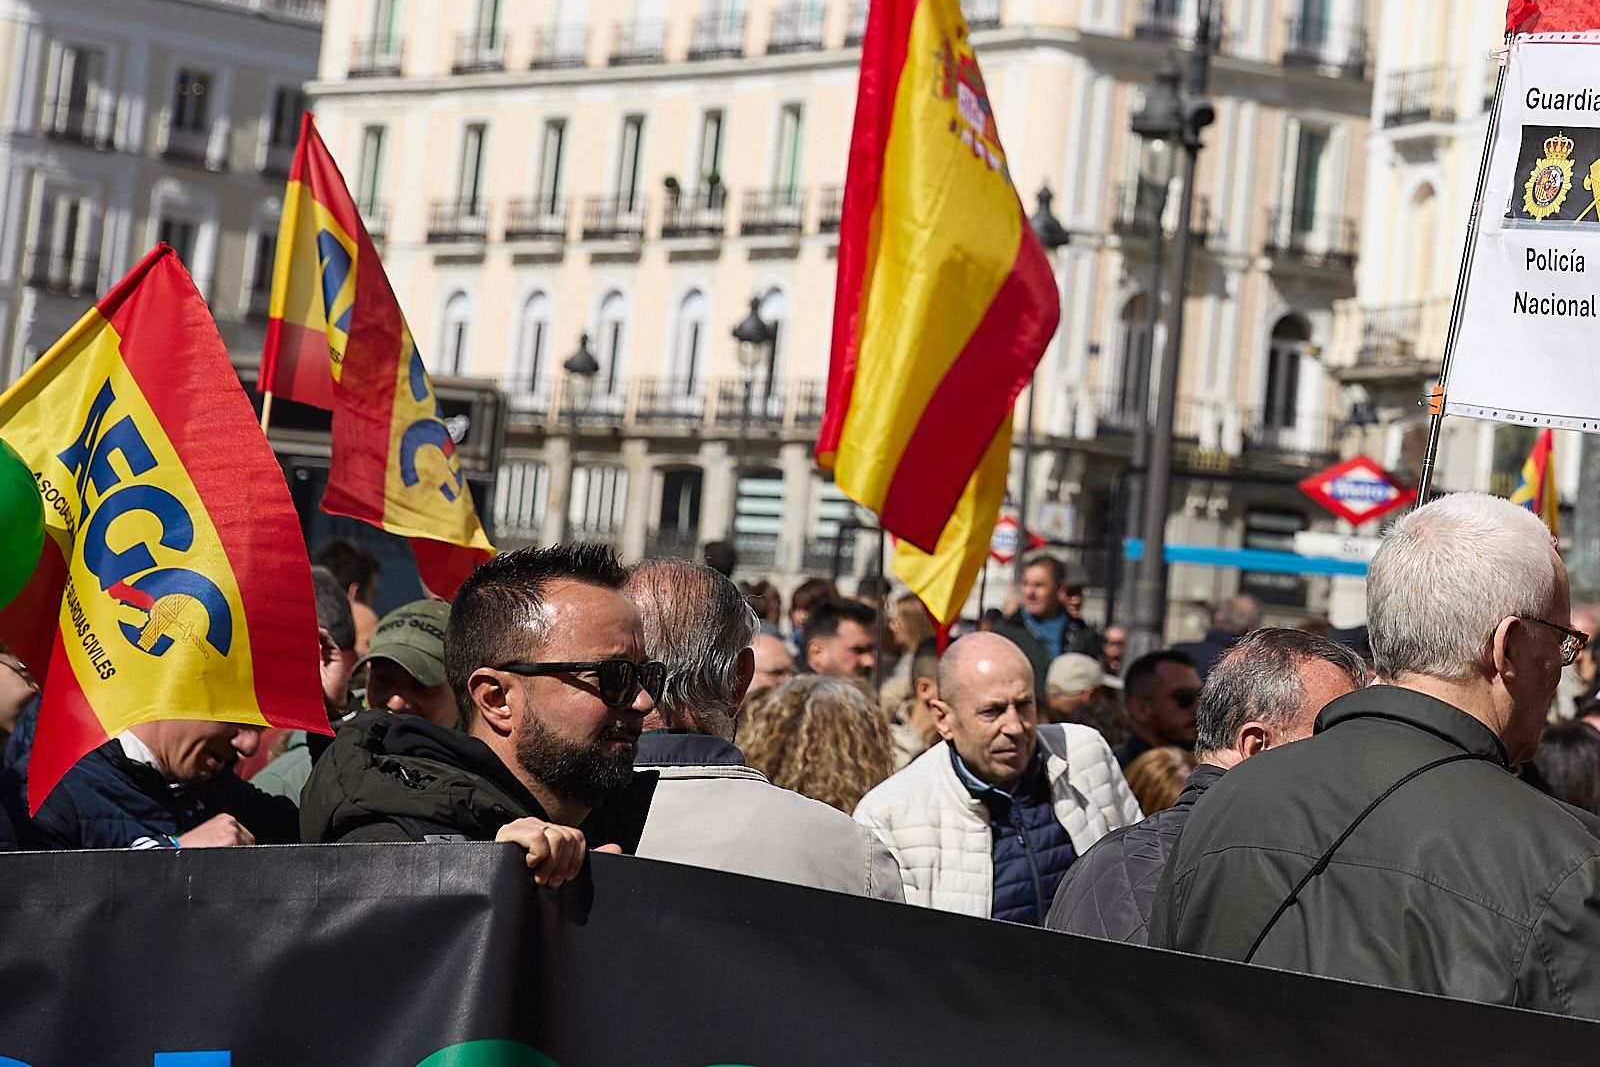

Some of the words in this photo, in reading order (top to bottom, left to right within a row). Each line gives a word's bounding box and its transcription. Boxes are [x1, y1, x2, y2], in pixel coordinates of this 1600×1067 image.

[1526, 247, 1585, 273] Policía
[1513, 291, 1597, 318] Nacional
[57, 376, 232, 657] AEGC
[82, 633, 116, 680] CIVILES
